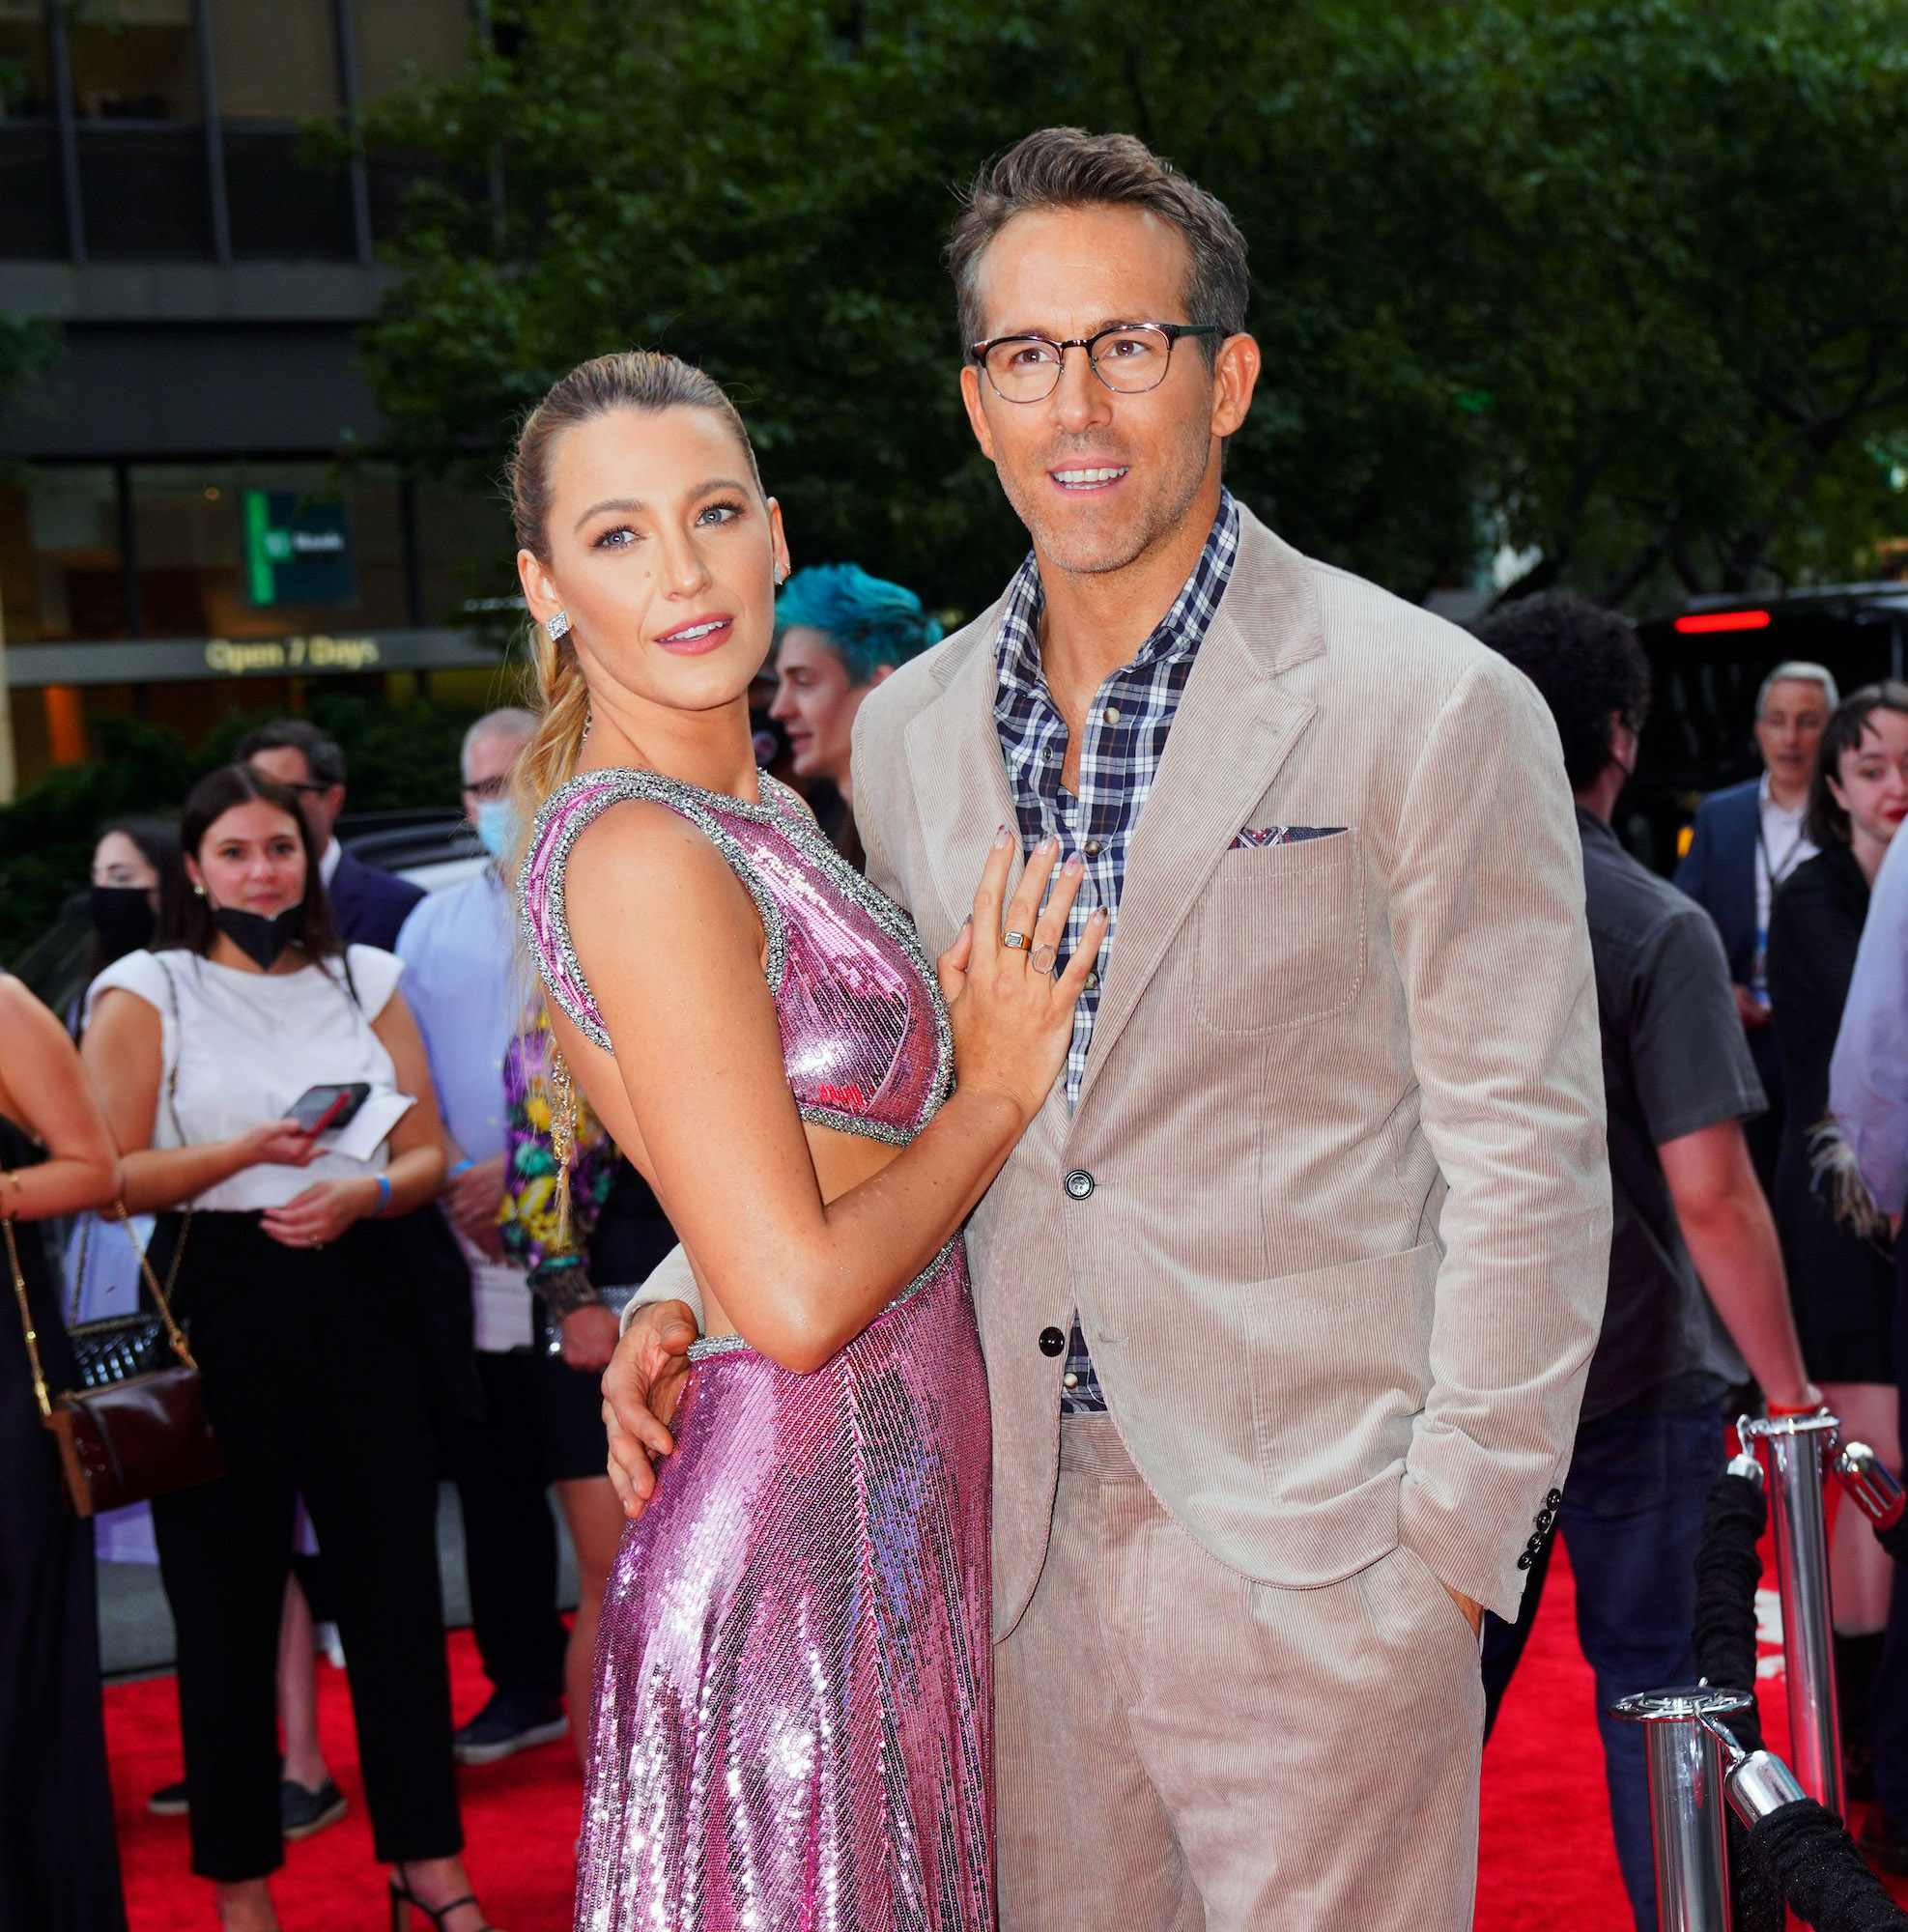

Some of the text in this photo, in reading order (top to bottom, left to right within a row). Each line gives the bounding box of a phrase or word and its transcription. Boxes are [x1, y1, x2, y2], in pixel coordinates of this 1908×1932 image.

[205, 634, 379, 674] Open 7 Days
